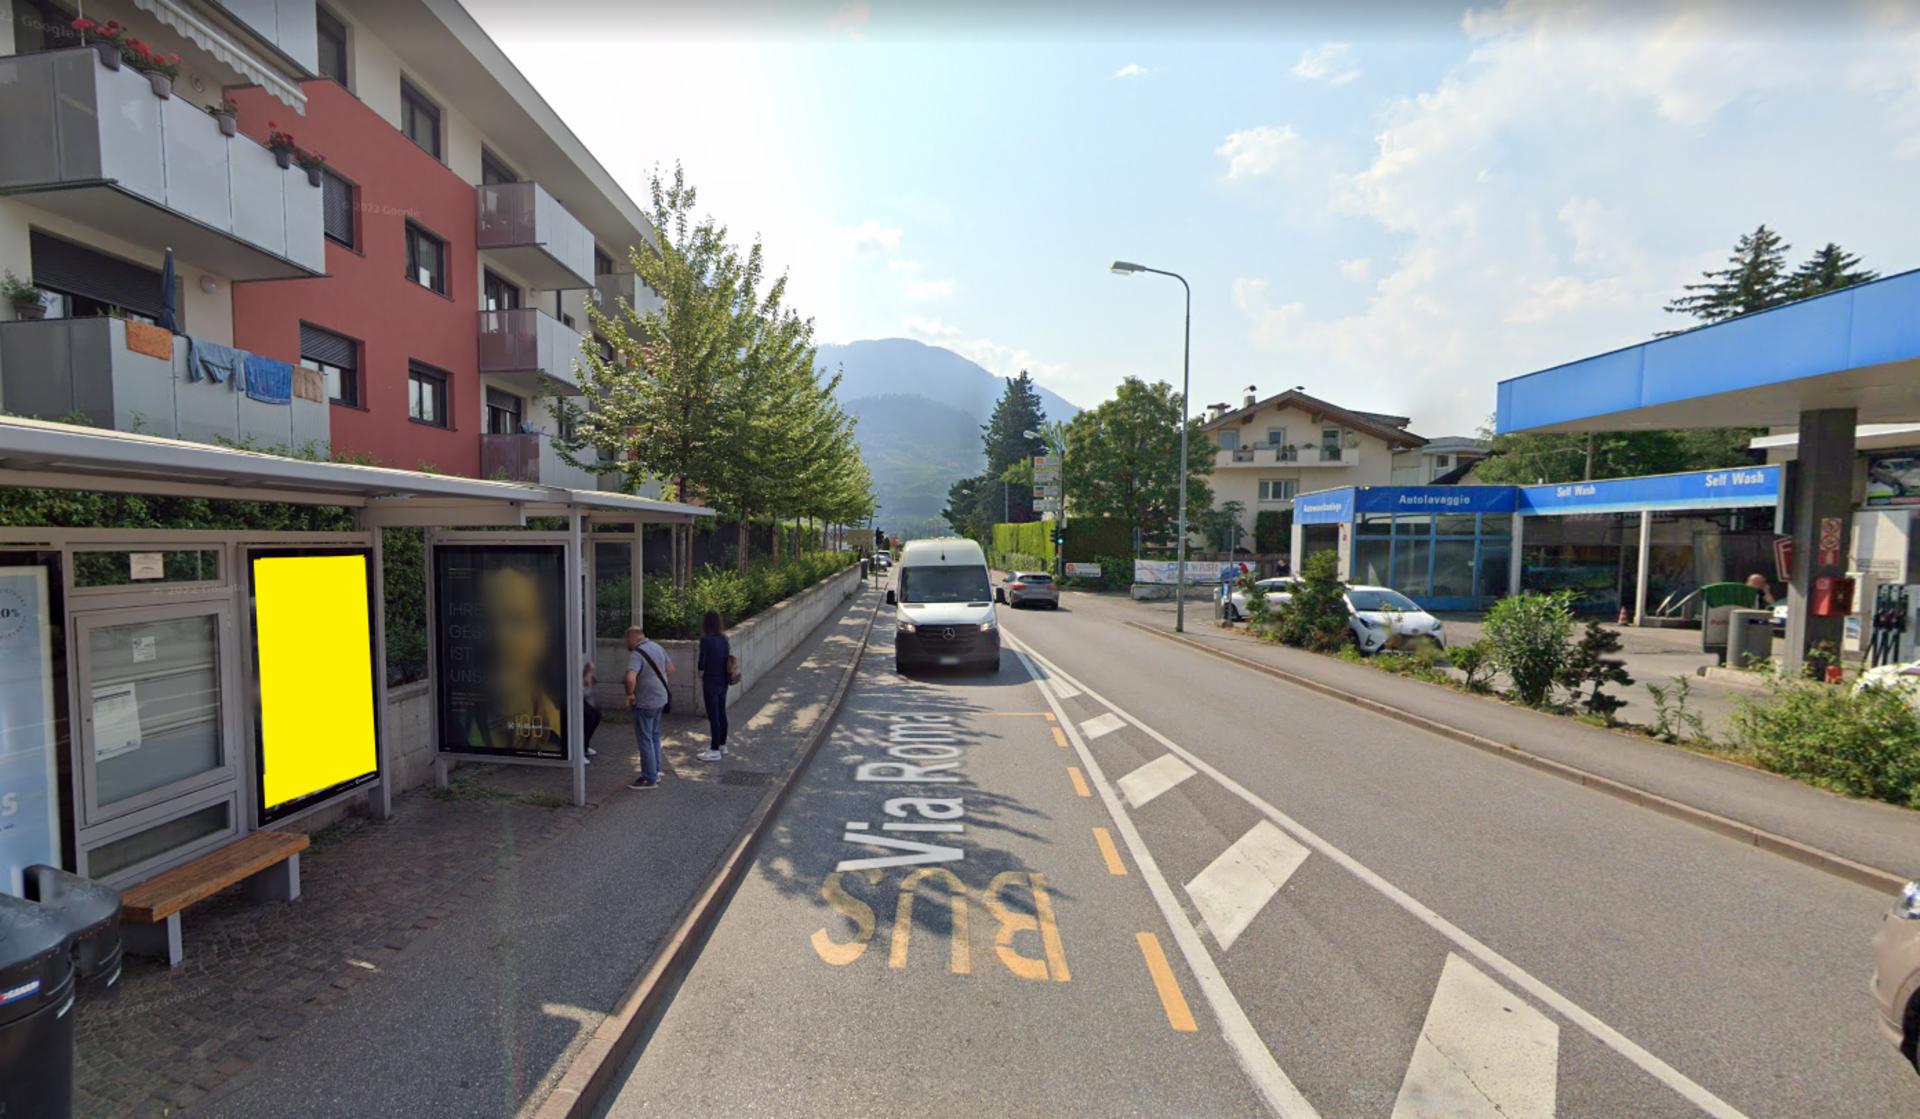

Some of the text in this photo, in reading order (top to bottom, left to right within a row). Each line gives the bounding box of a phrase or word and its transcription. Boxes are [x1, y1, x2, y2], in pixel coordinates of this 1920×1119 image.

[1705, 471, 1764, 487] Self Wash
[1556, 484, 1596, 497] Self Wash
[1399, 495, 1471, 506] Autolavaggio
[450, 647, 473, 661] IST
[810, 867, 1071, 983] BUS
